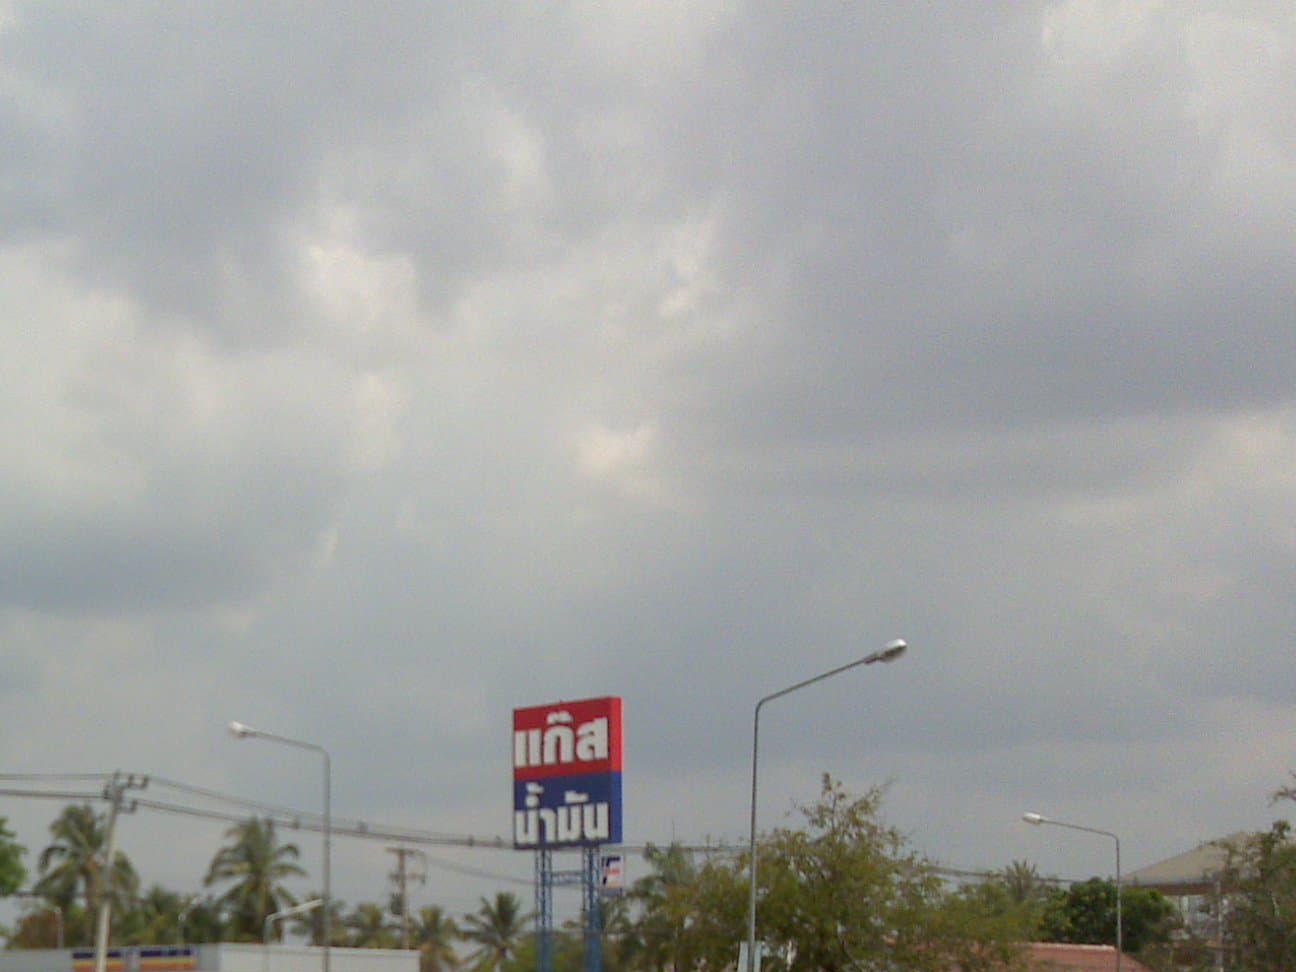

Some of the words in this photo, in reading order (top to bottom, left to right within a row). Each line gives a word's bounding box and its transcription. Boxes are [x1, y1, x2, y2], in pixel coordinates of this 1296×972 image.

[514, 710, 609, 769] แก๊ส
[515, 781, 609, 845] น้ำมัน
